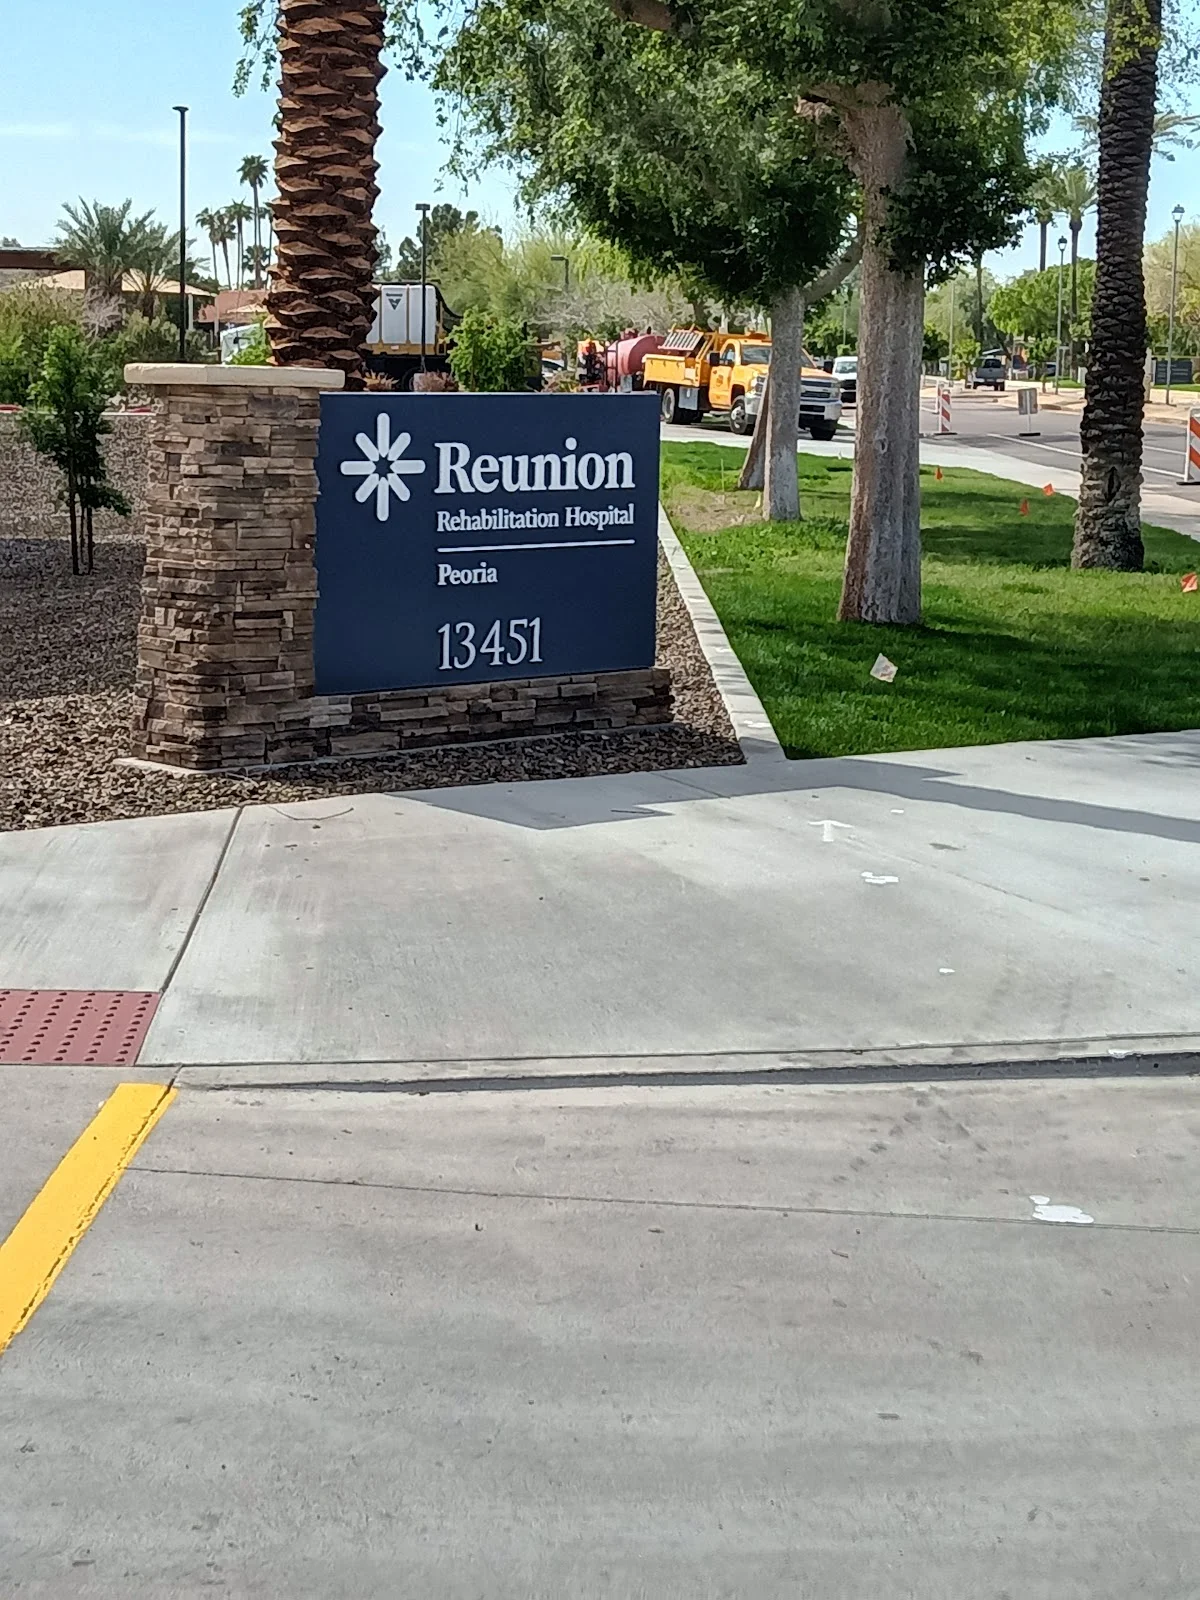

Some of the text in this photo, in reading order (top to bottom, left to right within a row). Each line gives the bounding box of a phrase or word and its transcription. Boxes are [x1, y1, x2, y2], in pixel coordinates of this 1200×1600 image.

[434, 437, 636, 494] Reunion
[437, 503, 634, 532] Rehabilitation Hospital
[437, 562, 498, 586] Peoria
[438, 617, 542, 670] 13451
